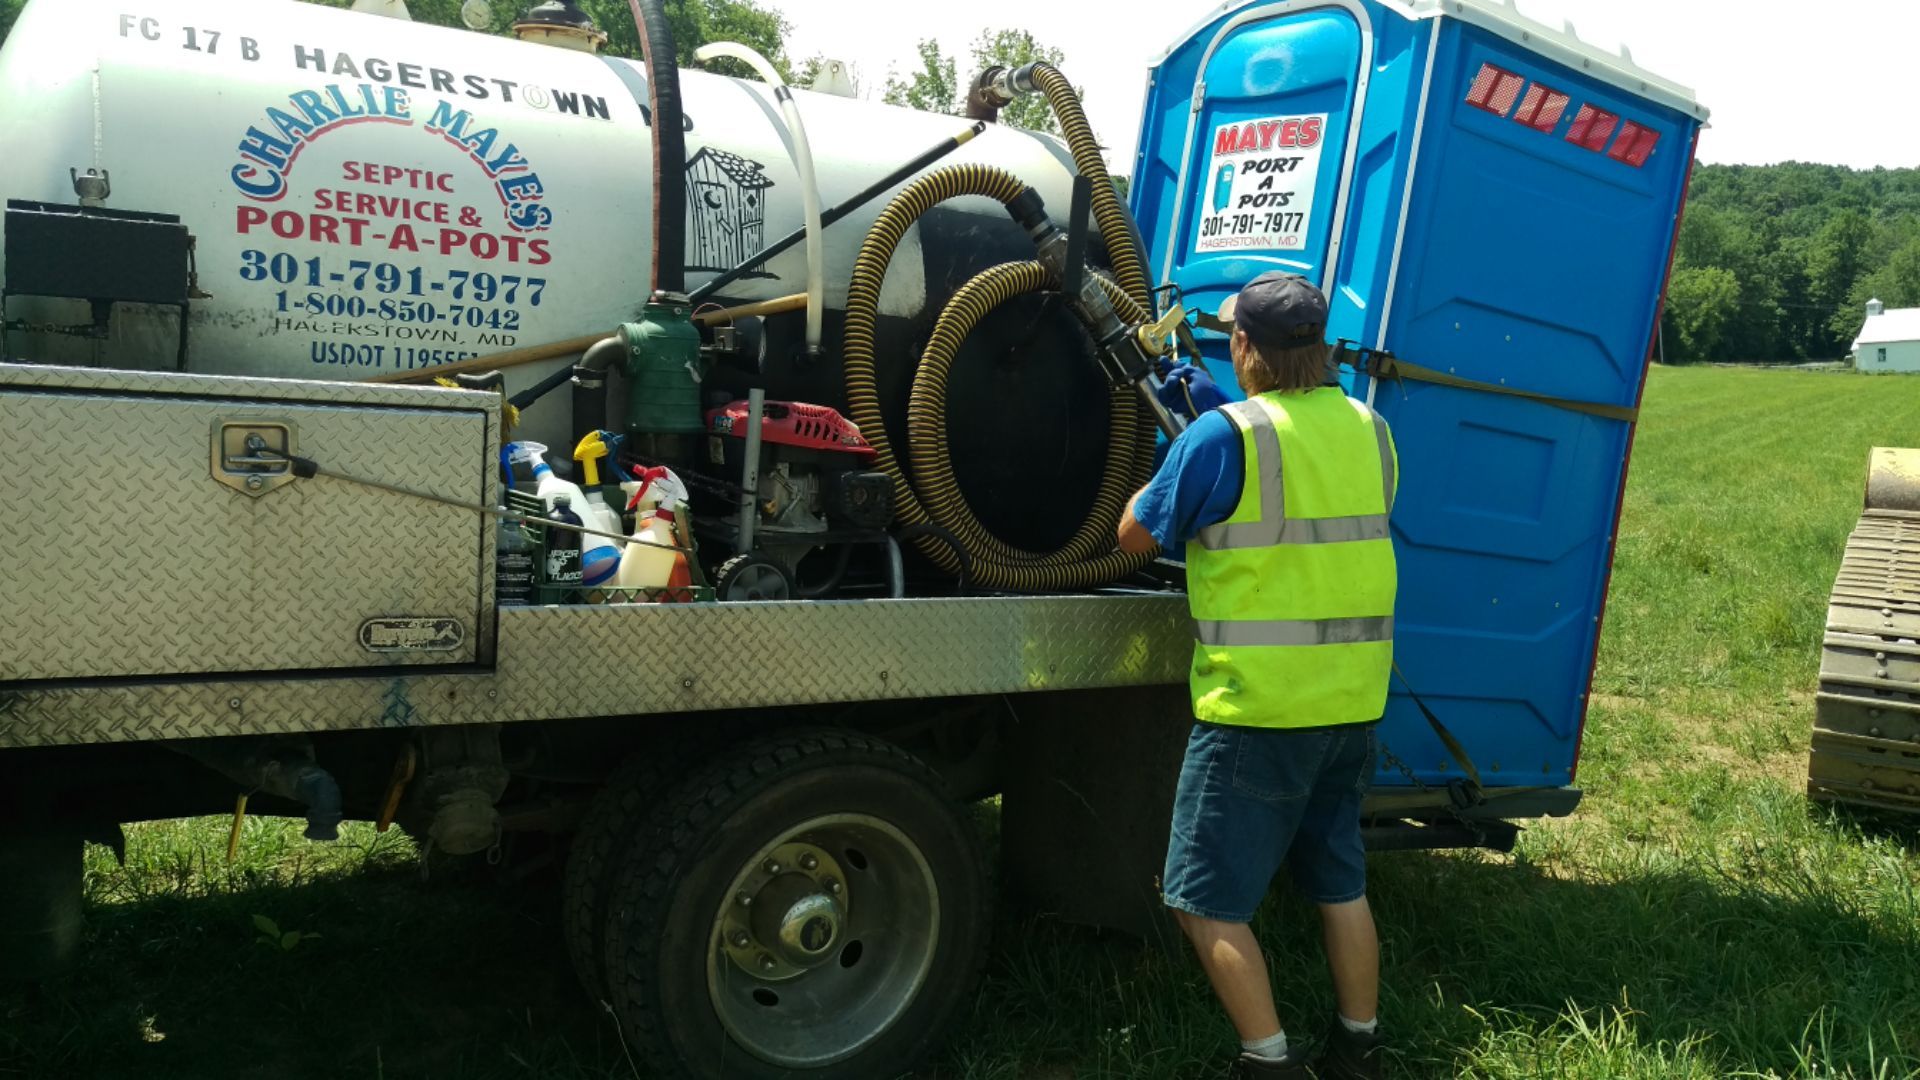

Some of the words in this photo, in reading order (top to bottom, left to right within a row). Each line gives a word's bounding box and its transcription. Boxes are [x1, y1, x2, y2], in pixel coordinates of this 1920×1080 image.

[119, 13, 161, 41] FC
[182, 26, 221, 55] 17
[240, 36, 261, 62] B
[293, 44, 611, 121] HAGERSTOWN
[1215, 118, 1321, 156] MAYES
[231, 83, 414, 202] CHARLIE
[424, 98, 553, 232] MAYES
[1241, 157, 1304, 175] PORT
[342, 161, 455, 194] SEPTIC
[1257, 175, 1274, 191] A
[314, 188, 449, 224] SERVICE
[457, 206, 483, 228] &
[1237, 192, 1295, 209] POTS
[236, 205, 552, 265] PORT-A-POTS
[1202, 212, 1304, 237] 301-791-7977
[1278, 235, 1299, 246] MD
[239, 249, 547, 307] 301-791-7977
[275, 289, 520, 331] 1-800-850-7042
[311, 340, 384, 368] USDOT
[477, 332, 517, 347] MD
